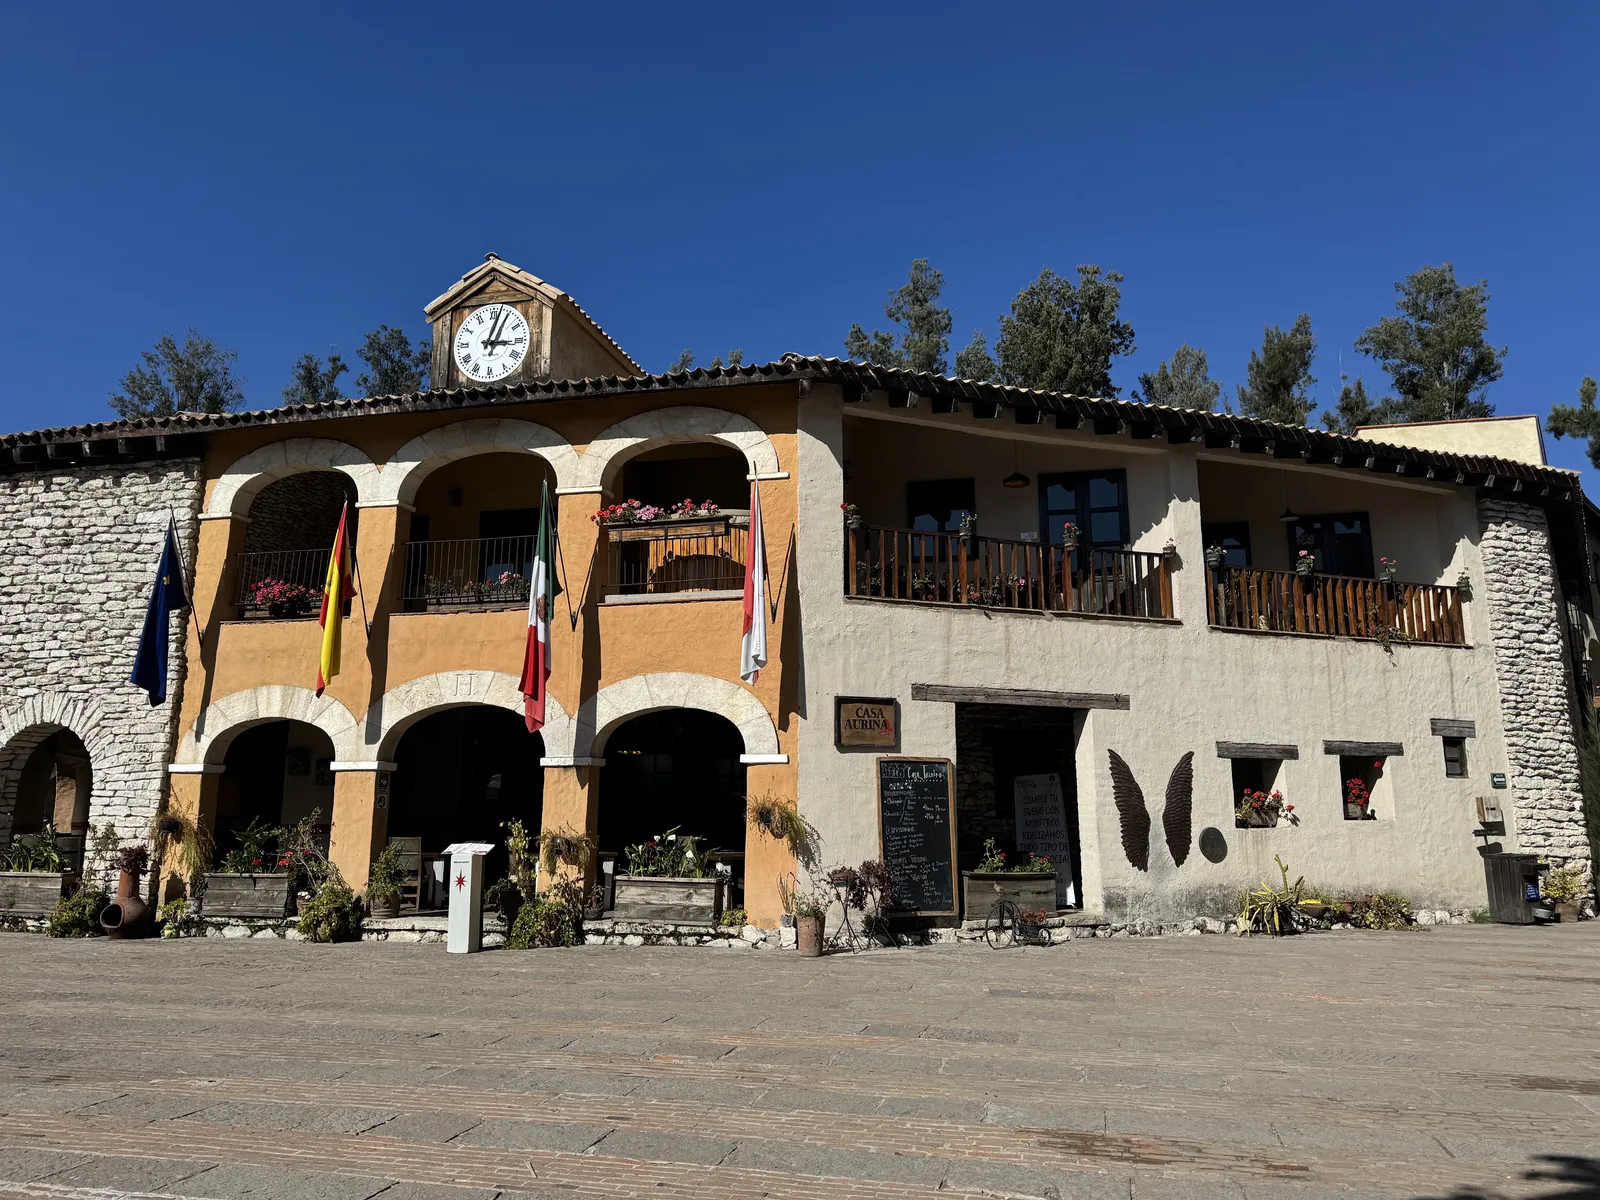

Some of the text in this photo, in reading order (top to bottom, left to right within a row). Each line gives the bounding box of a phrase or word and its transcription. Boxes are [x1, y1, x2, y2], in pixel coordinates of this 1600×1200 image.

[855, 706, 885, 719] CASA
[844, 718, 888, 730] AURINA
[1023, 793, 1059, 804] CUMPLE TU
[1023, 805, 1060, 816] SUEÑO CON
[1025, 818, 1060, 828] NOSOTROS
[1022, 830, 1065, 840] REALIZAMOS
[1020, 842, 1068, 852] TODO TIPO DE
[1047, 854, 1071, 864] OCIAL
